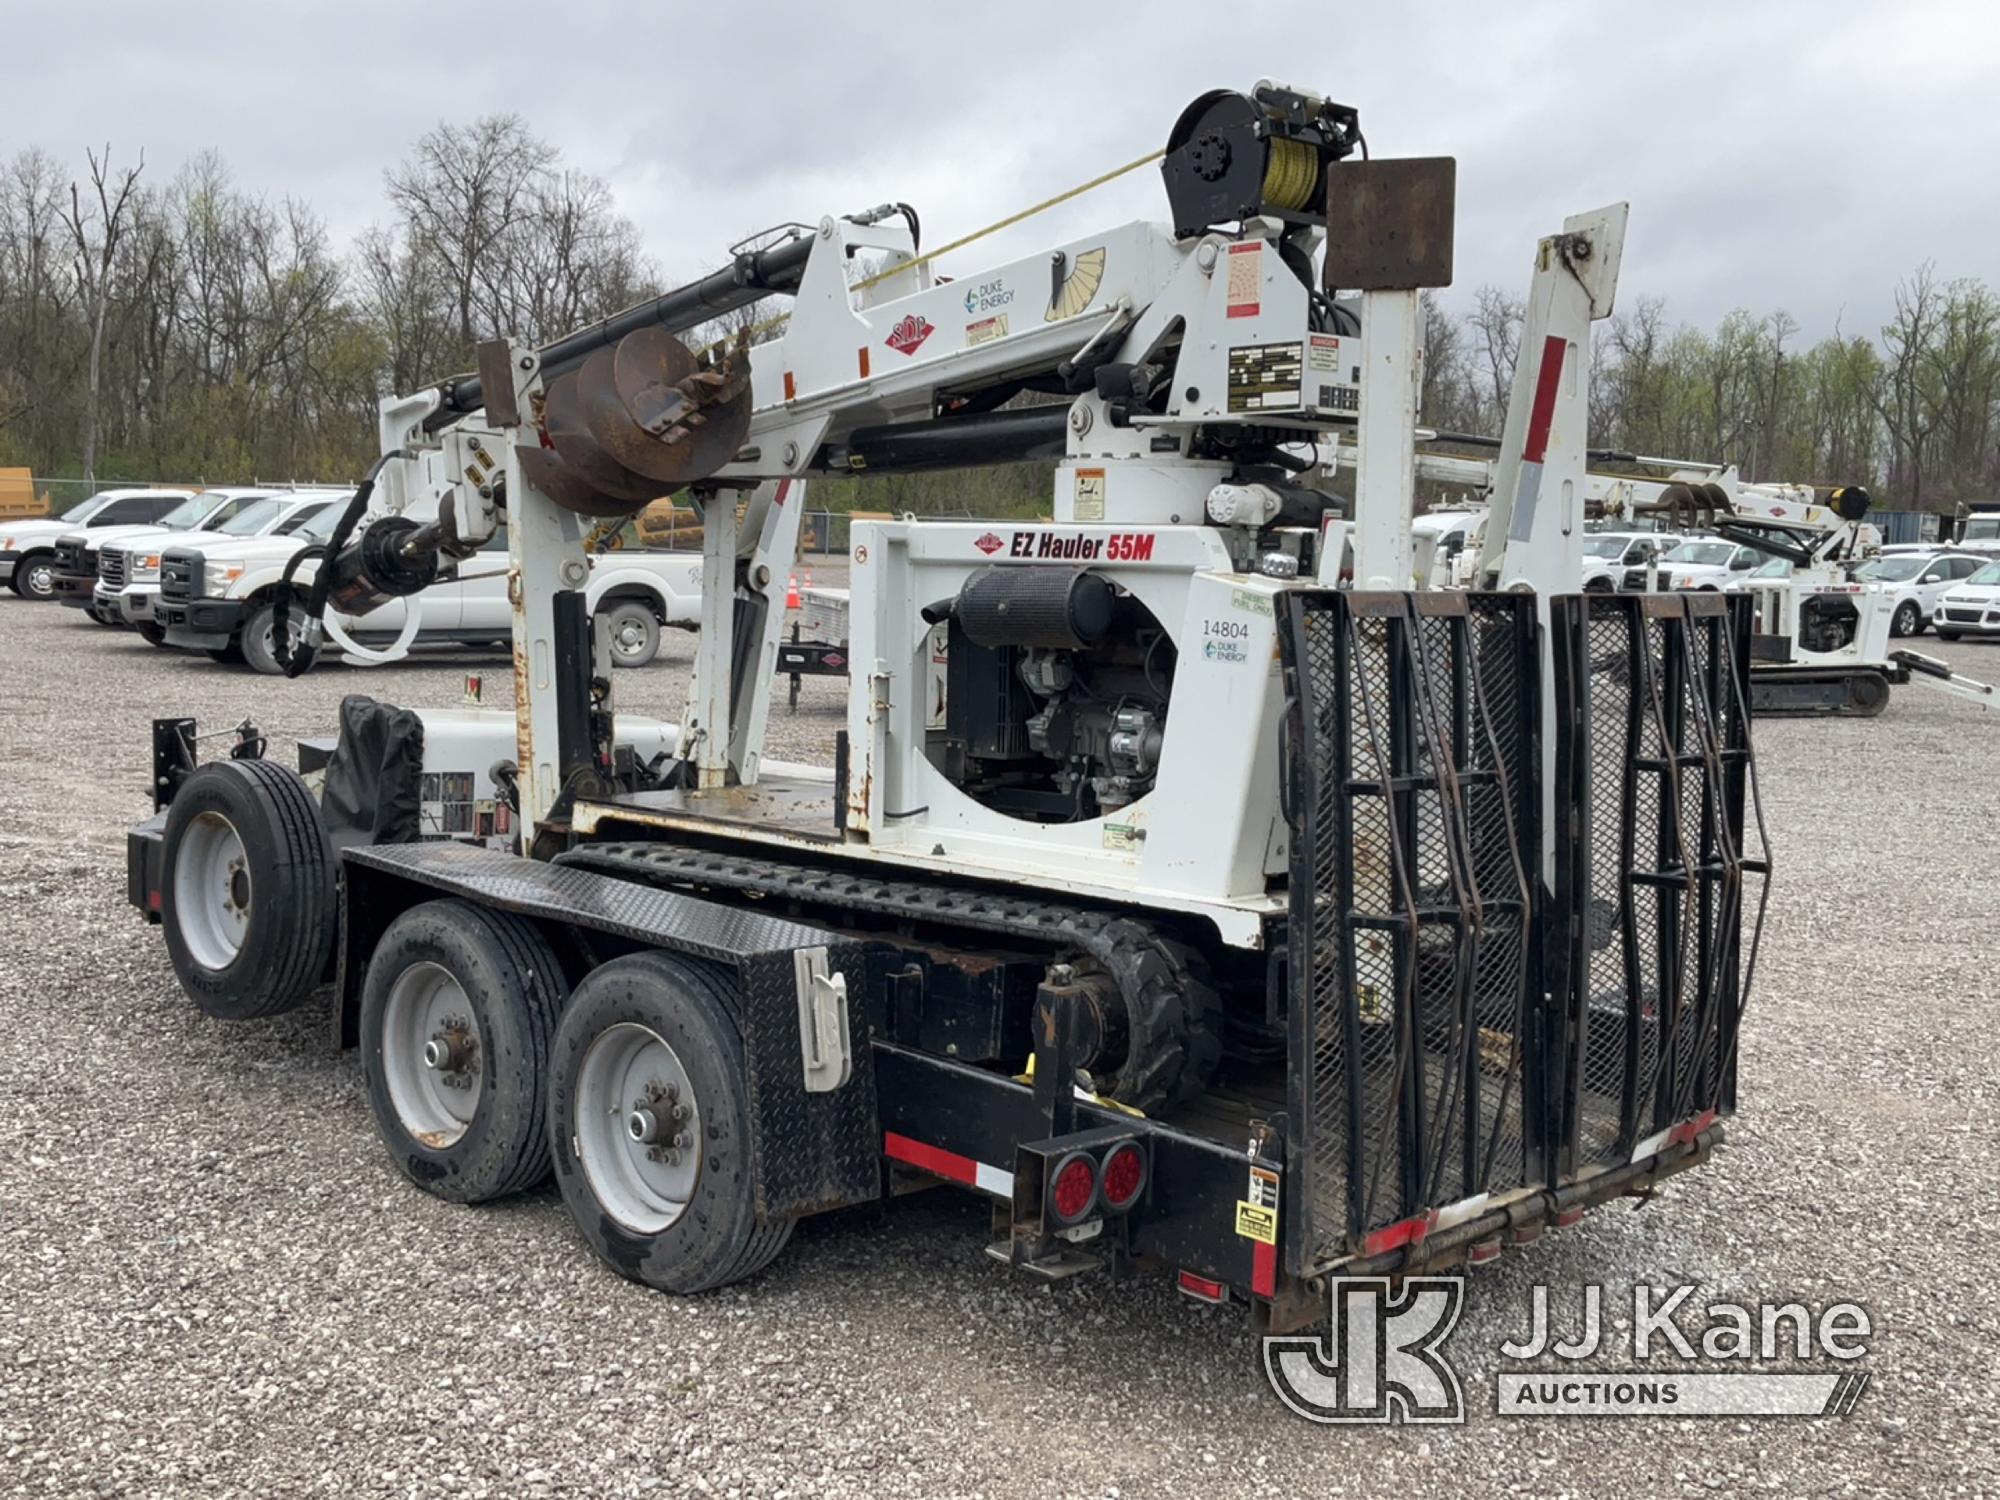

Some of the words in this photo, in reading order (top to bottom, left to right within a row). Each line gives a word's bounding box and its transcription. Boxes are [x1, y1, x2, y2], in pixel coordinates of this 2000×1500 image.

[979, 279, 1004, 297] DUKE
[980, 289, 1015, 311] ENERGY
[892, 316, 926, 343] SDP
[1010, 532, 1036, 557] EZ
[1037, 532, 1103, 559] Hauler
[1106, 534, 1155, 561] 55M
[1203, 619, 1248, 639] 14804
[1217, 642, 1237, 652] DUKE
[1217, 652, 1246, 662] ENERGY
